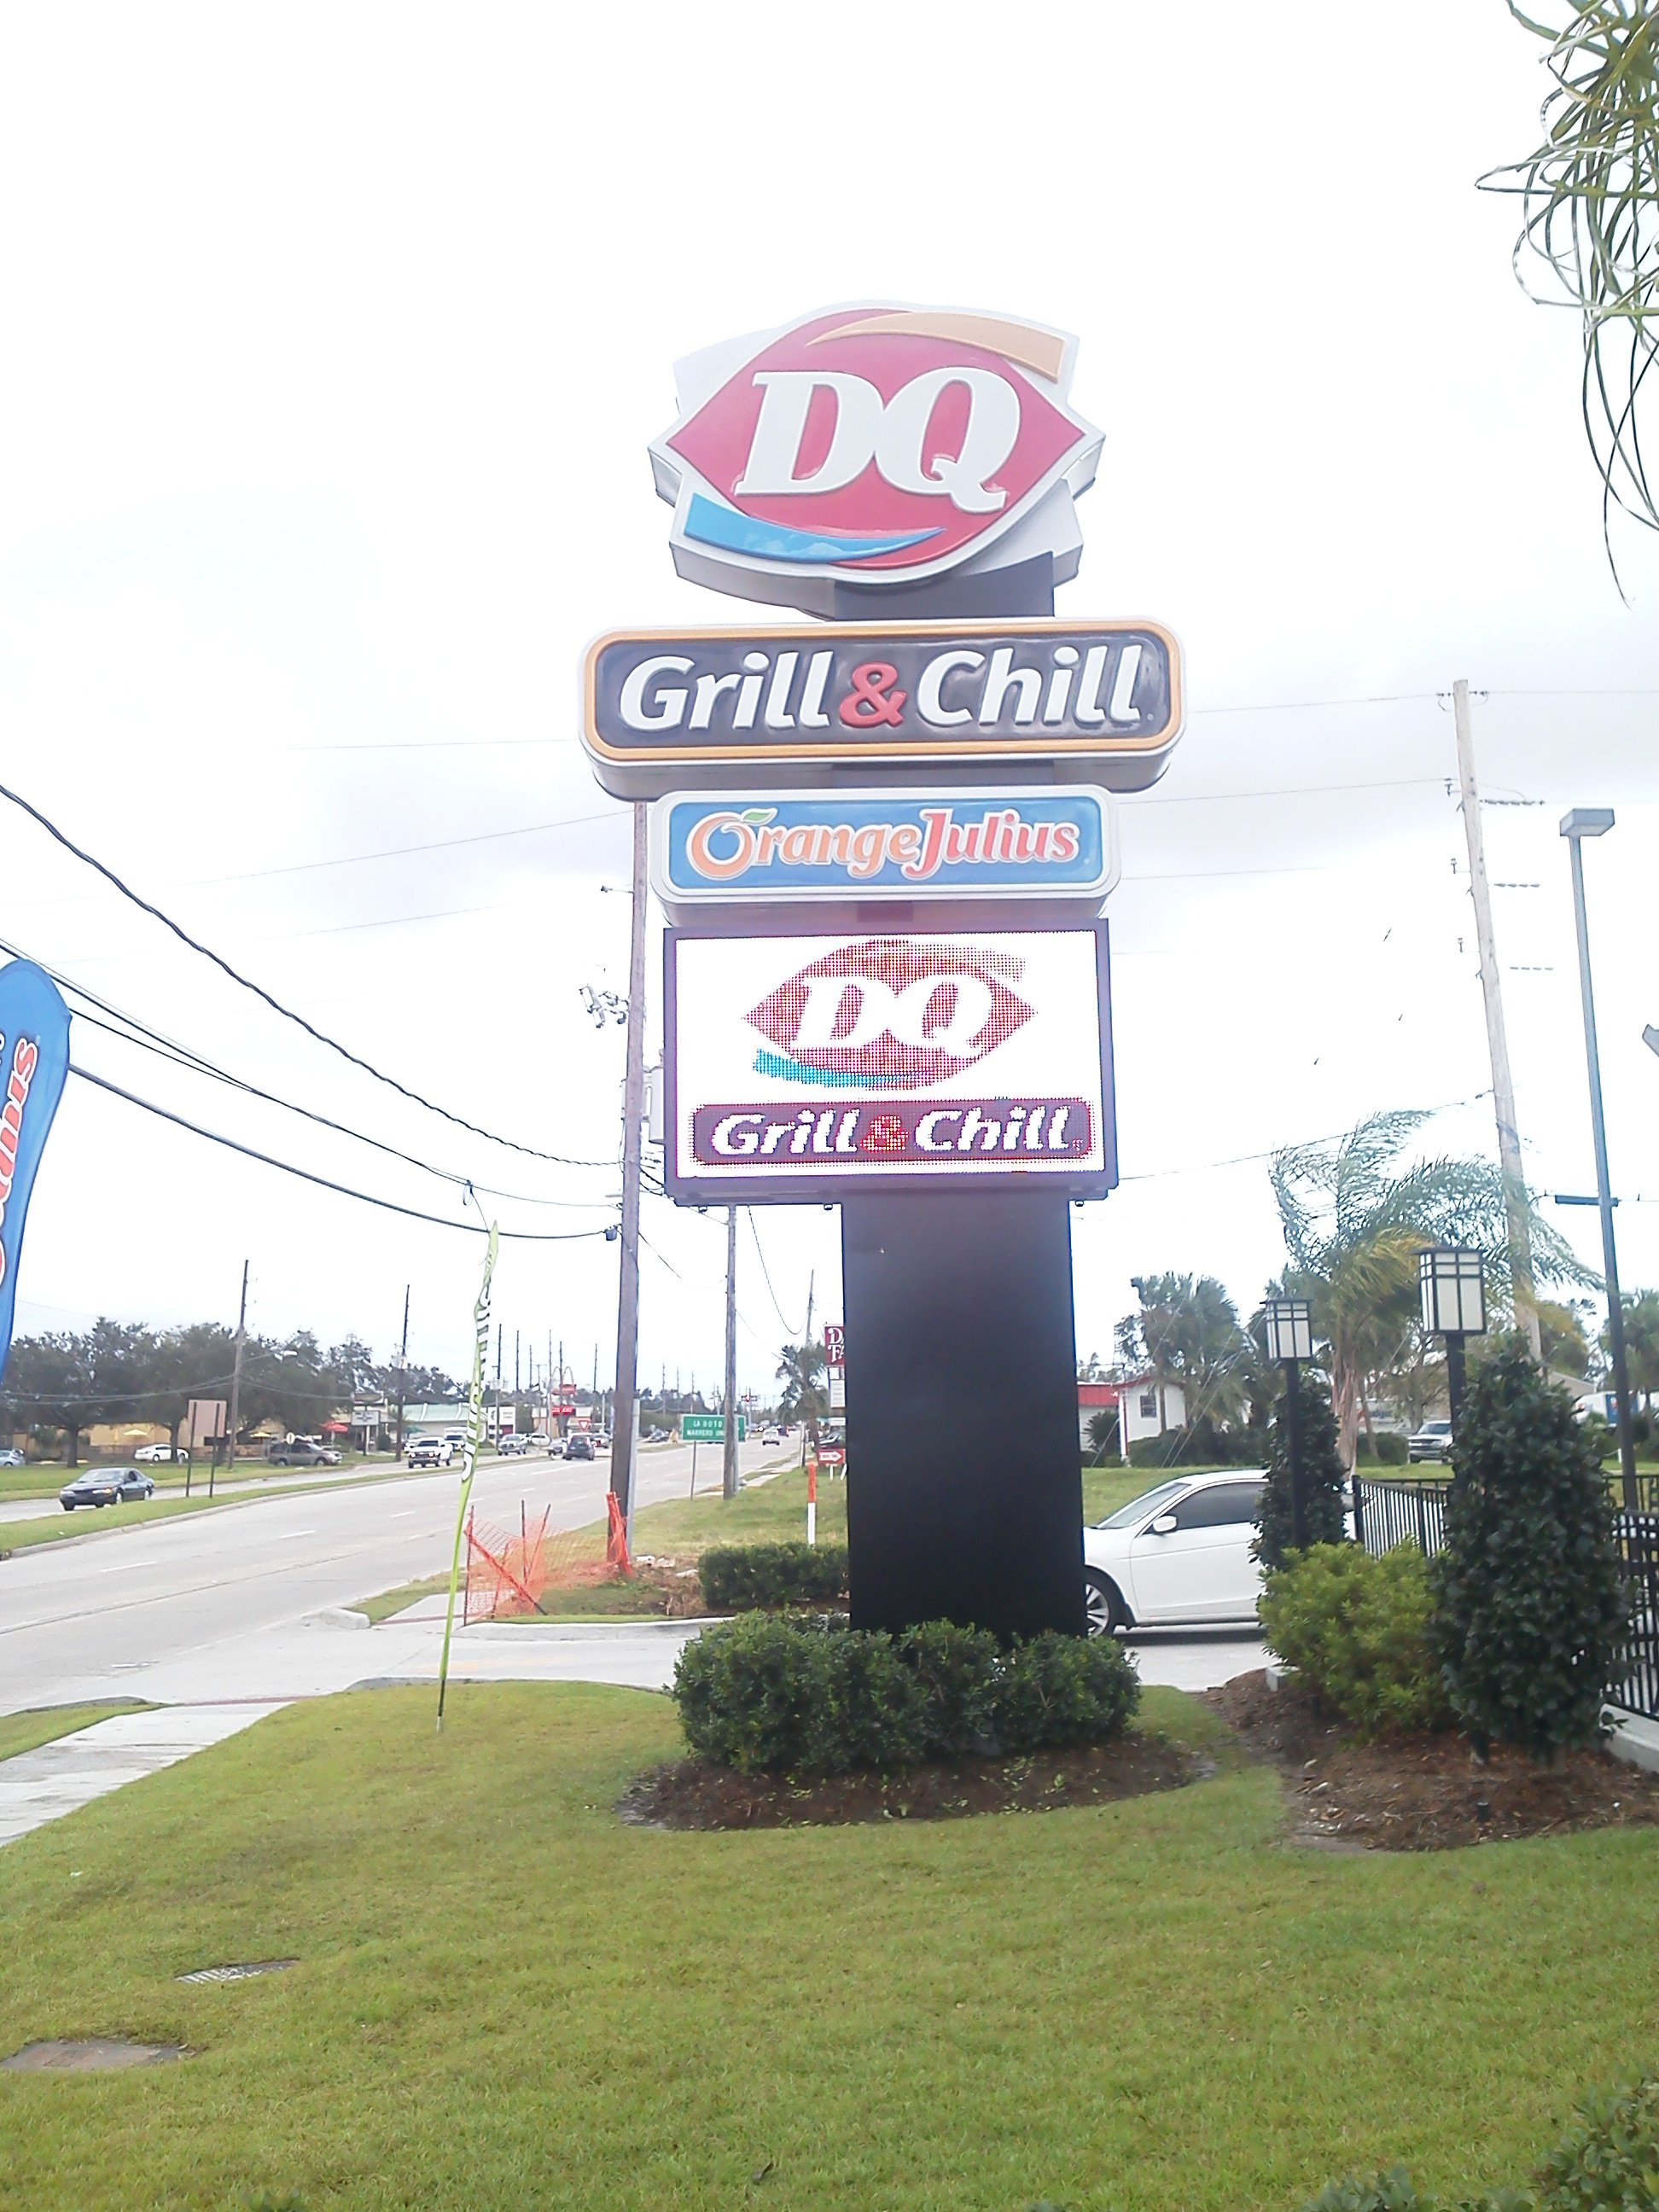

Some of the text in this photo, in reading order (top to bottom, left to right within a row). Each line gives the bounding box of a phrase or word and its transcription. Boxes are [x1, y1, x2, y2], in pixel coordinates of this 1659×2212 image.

[734, 366, 1022, 513] DQ
[620, 644, 1144, 731] Grill & Chill
[789, 974, 993, 1057] DQ
[712, 1106, 1070, 1155] Grill & Chill
